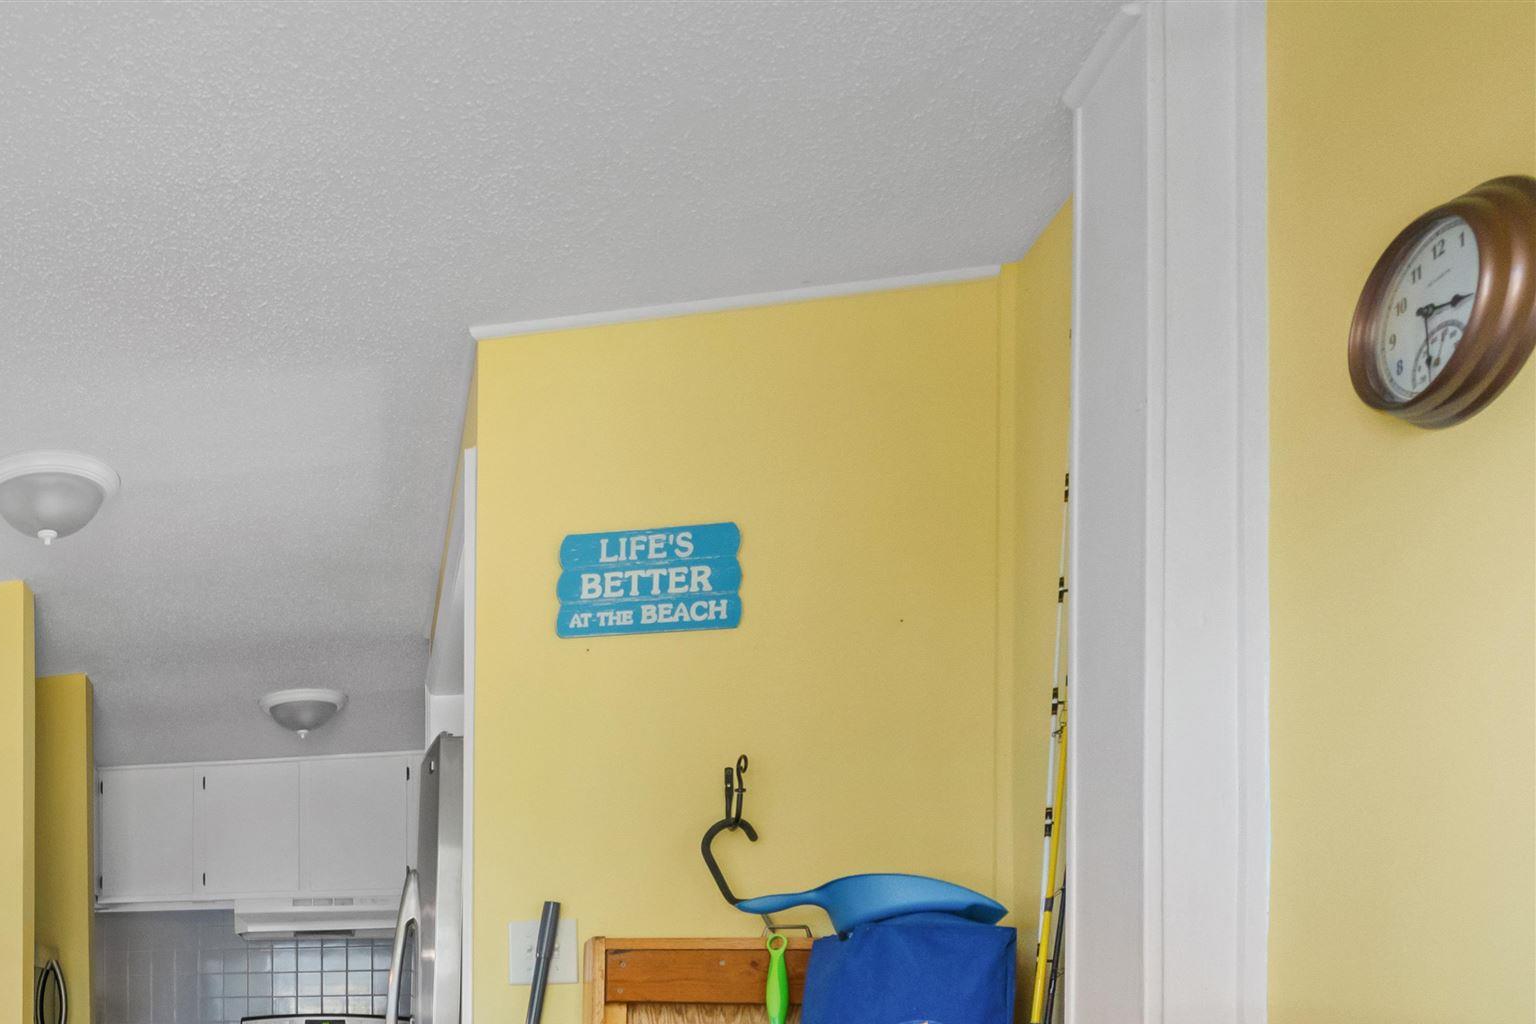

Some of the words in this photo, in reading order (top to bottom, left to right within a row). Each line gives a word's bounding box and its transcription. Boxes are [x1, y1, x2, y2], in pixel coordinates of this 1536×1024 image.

[1431, 238, 1445, 260] 12
[1411, 265, 1422, 284] 11
[1395, 297, 1407, 317] 10
[1388, 334, 1396, 351] 9
[1396, 359, 1403, 376] 8
[599, 531, 694, 563] LIFE'S
[580, 565, 713, 600] BETTER
[568, 612, 593, 629] AT
[596, 610, 634, 627] THE
[640, 599, 728, 624] BEACH
